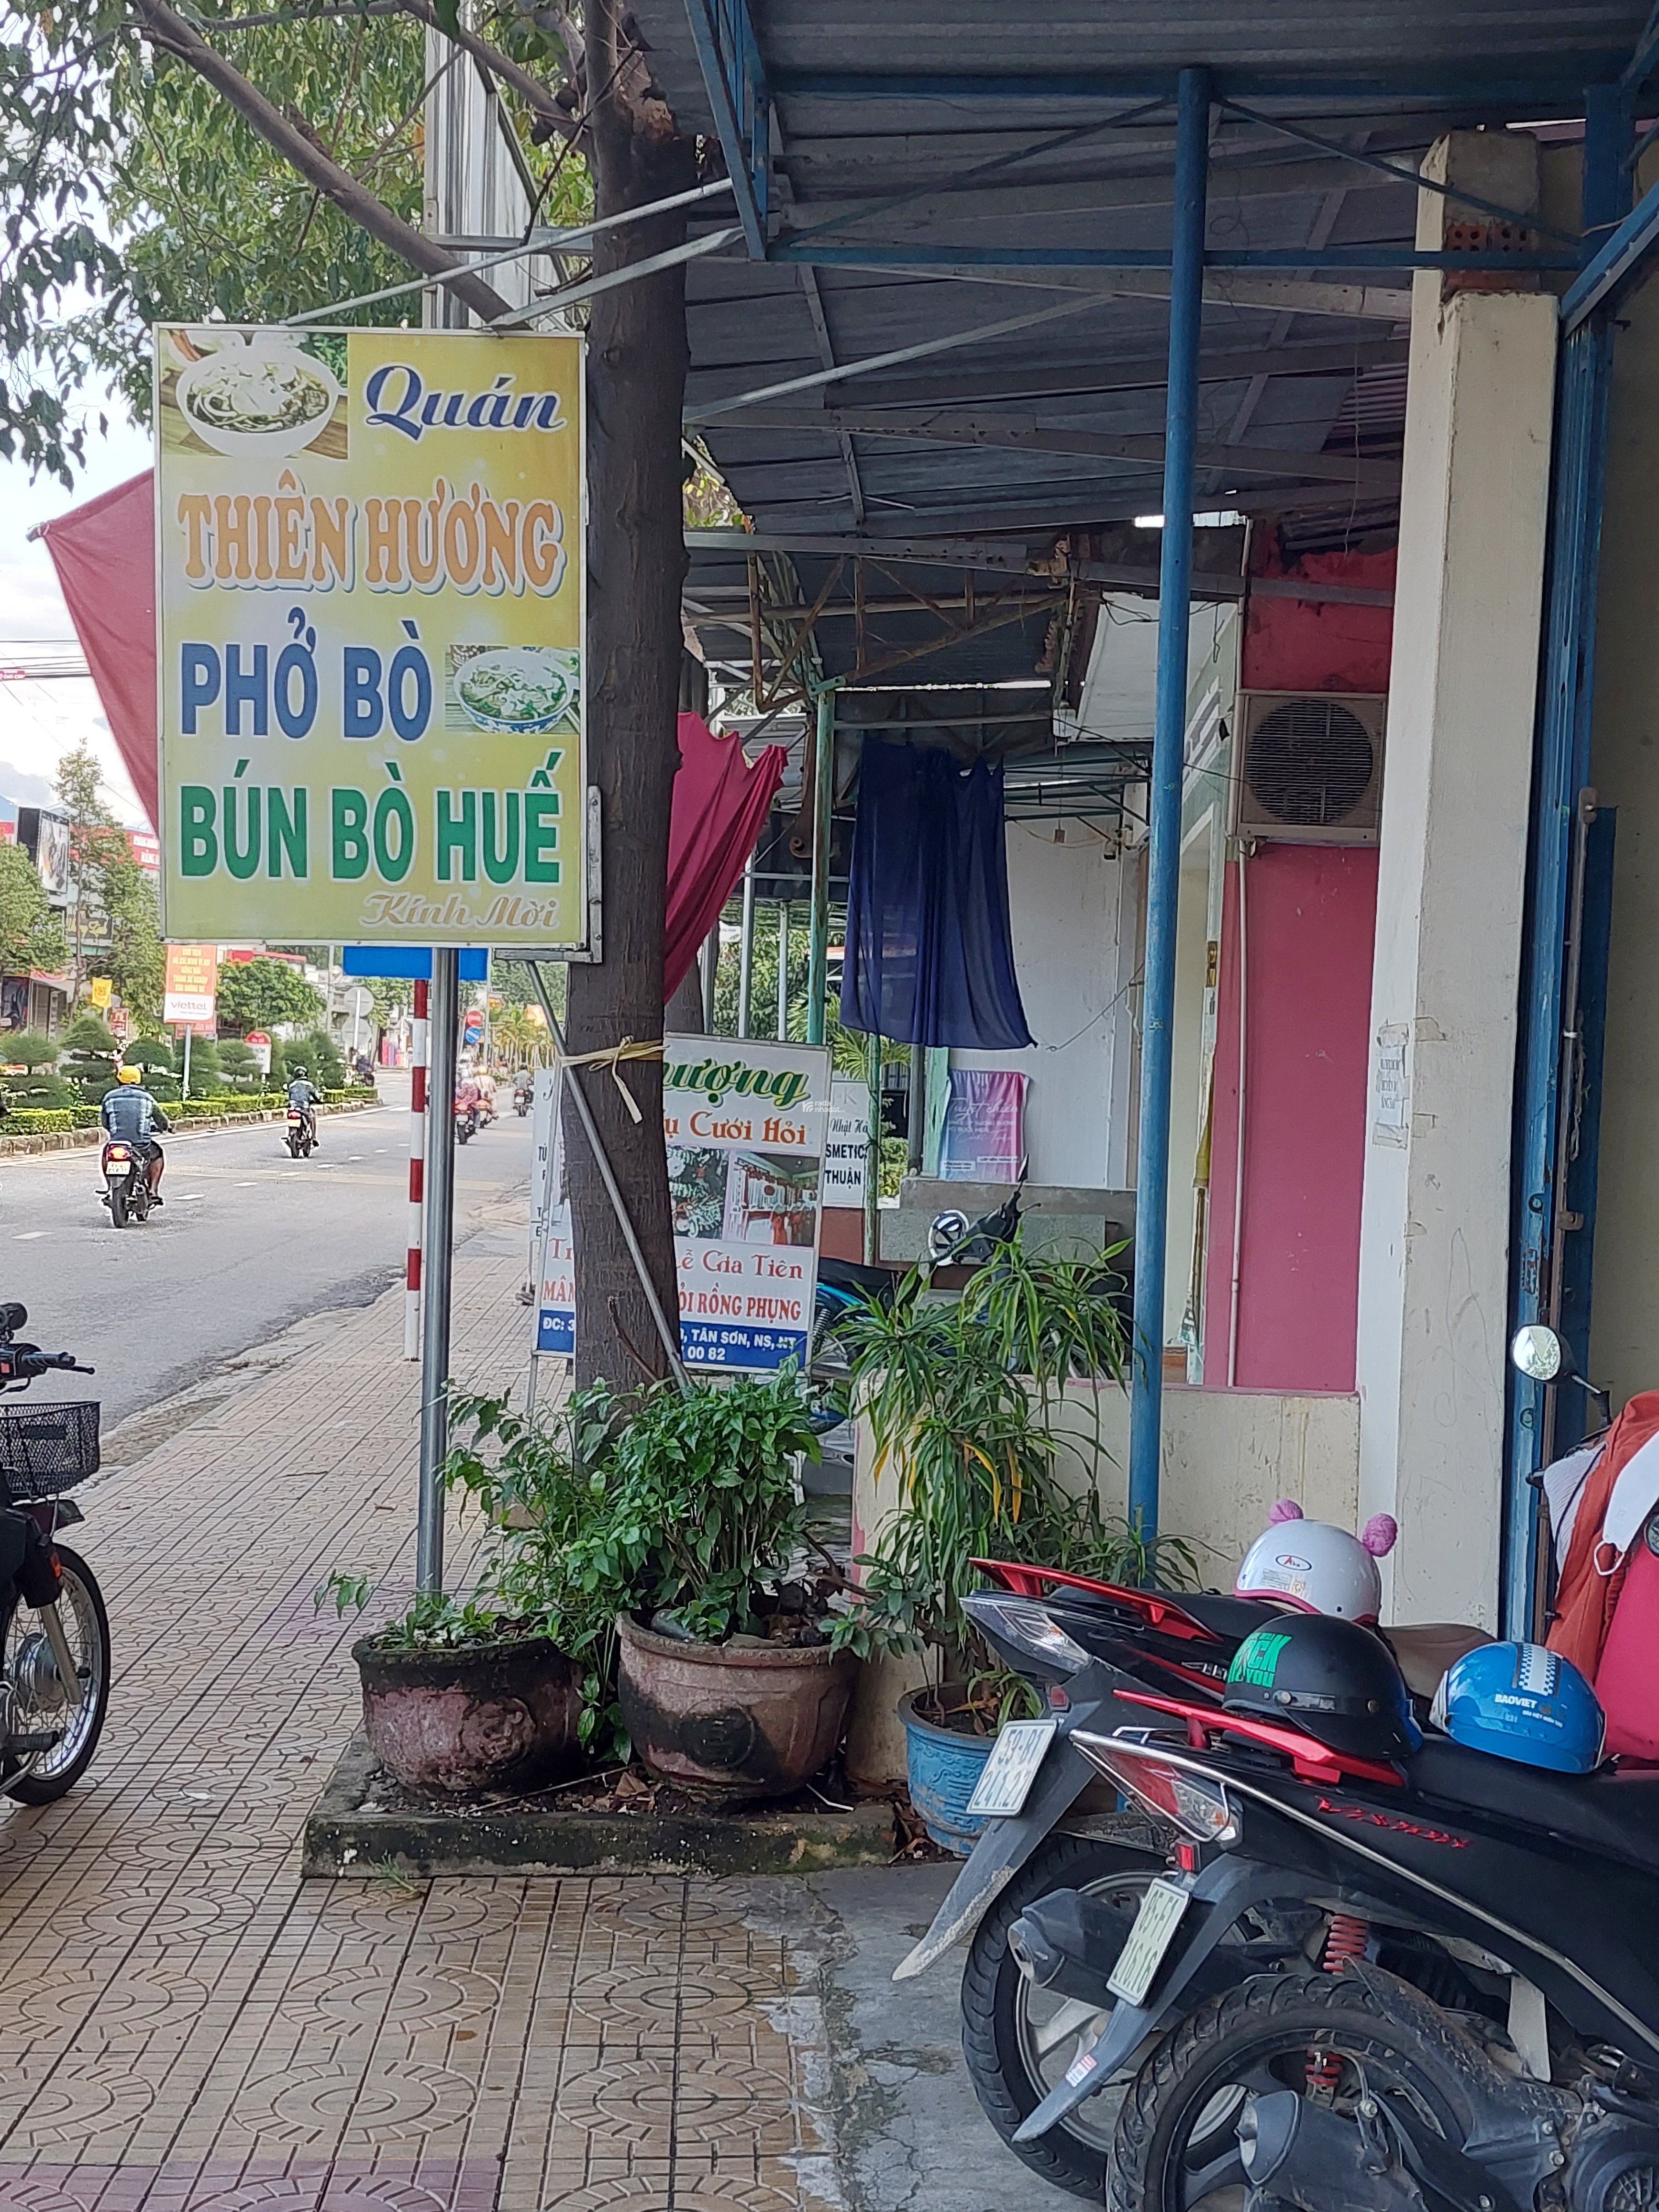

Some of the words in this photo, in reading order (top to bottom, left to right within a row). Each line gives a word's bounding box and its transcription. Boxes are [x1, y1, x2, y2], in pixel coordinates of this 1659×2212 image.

[366, 365, 563, 441] Quán
[177, 468, 355, 590] THIÊN
[365, 478, 564, 593] HƯƠNG
[181, 607, 319, 739] PHỞ
[343, 620, 432, 741] BÒ
[180, 759, 307, 880] BÚN
[331, 762, 414, 882] BÒ
[437, 752, 562, 884] HUẾ
[362, 895, 469, 925] Kính
[477, 896, 557, 928] Mời
[690, 1111, 752, 1140] Cưới
[762, 1117, 807, 1145] Hỏi
[751, 1254, 804, 1280] Tiên
[697, 1282, 742, 1316] RỒNG
[746, 1296, 801, 1324] PHỤNG
[691, 1327, 718, 1343] TÂN
[720, 1331, 751, 1348] SƠN,
[754, 1334, 775, 1350] NS,
[1494, 1693, 1538, 1709] BAOVIET
[997, 1728, 1045, 1766] 59-B1
[1138, 1889, 1180, 1942] 85-F1
